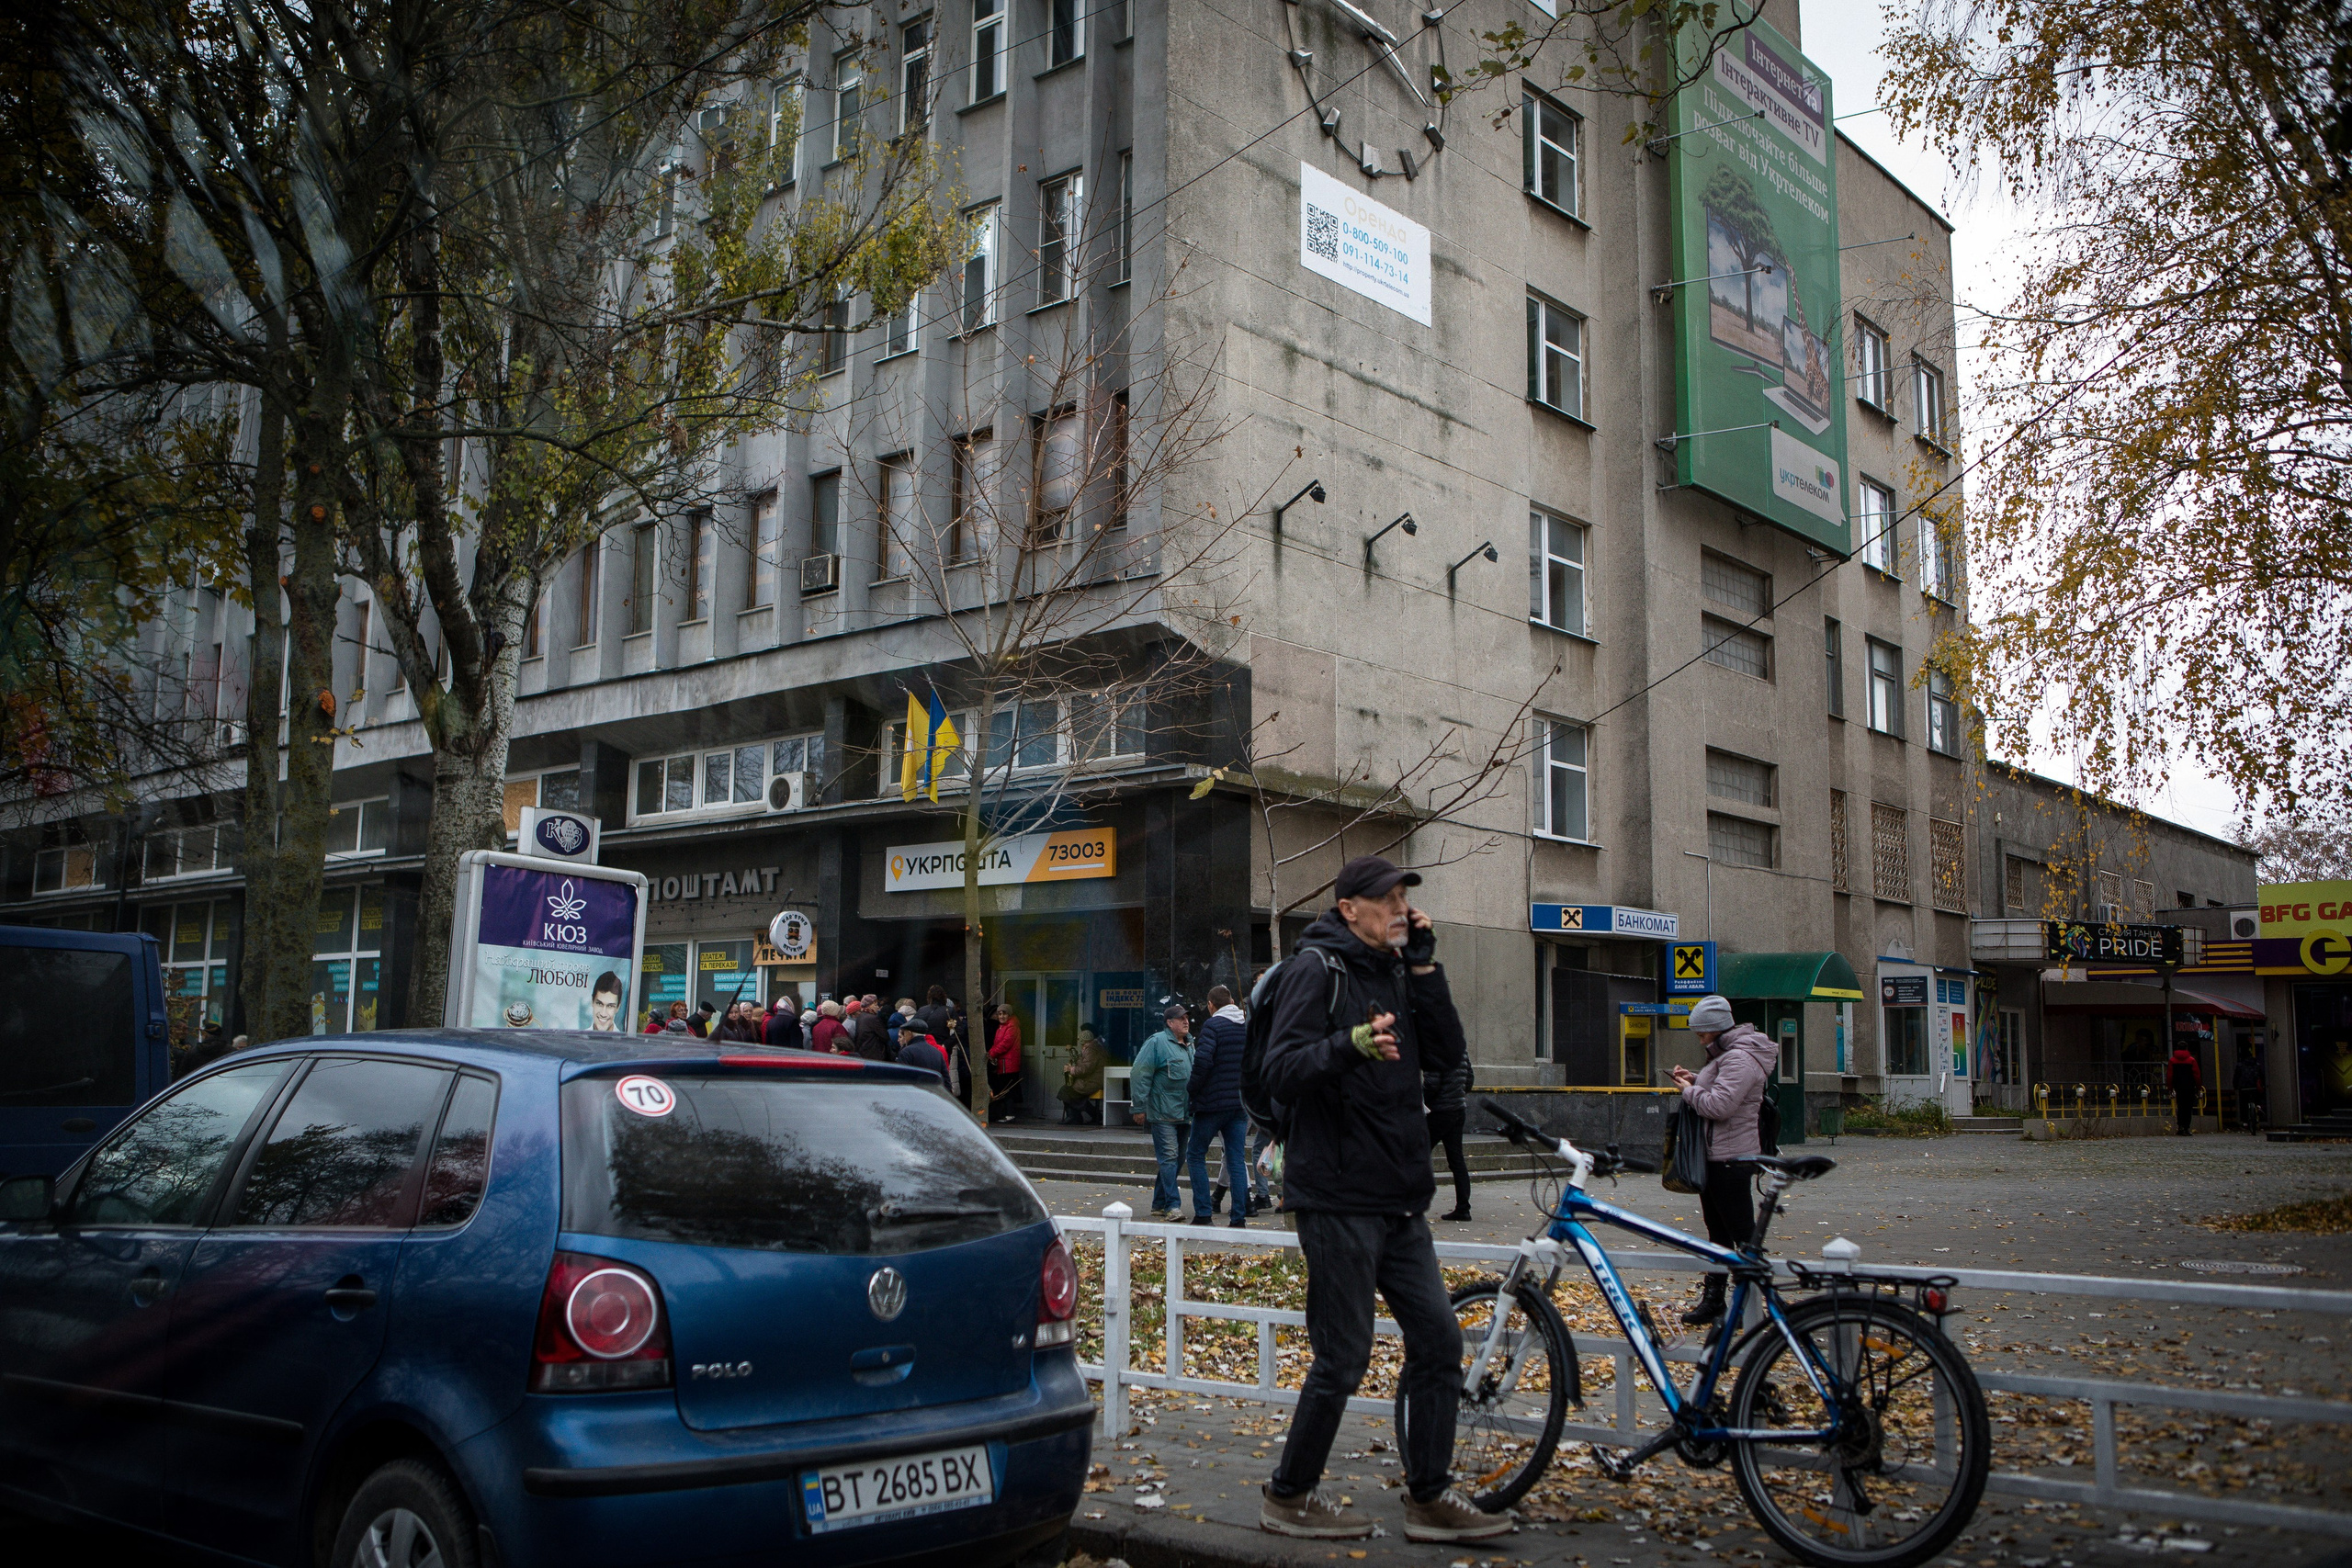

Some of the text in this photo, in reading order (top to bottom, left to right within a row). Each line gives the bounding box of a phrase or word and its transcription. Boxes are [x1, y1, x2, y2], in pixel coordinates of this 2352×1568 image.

[1751, 39, 1818, 113] Інтернет та
[1721, 52, 1819, 148] Інтерактивне TV
[1703, 85, 1828, 198] Підключайте більше
[1693, 109, 1829, 225] розваг від Укртелеком
[1344, 197, 1407, 243] Оренда
[1342, 221, 1408, 265] 0-800-509-100
[1342, 242, 1408, 285] 091-114-73-14
[1779, 468, 1830, 503] укртелеком
[1048, 841, 1105, 862] 73003
[649, 867, 780, 900] ПОШТАМТ
[1618, 914, 1675, 932] БАНКОМАТ
[2260, 901, 2352, 923] BFG GA
[544, 922, 587, 944] КЮЗ
[2133, 929, 2162, 938] ТАНЦА
[523, 939, 603, 954] КИЇВСЬКИЙ ЮВЕЛІРНИЙ ЗАВОД
[2099, 938, 2163, 957] PRIDE
[485, 951, 591, 974] Найкращий прояв
[708, 961, 737, 969] ПЕРЕКАЗИ
[527, 969, 588, 988] ЛЮБОВІ
[1974, 976, 1997, 990] PRIDE
[628, 1086, 664, 1105] 70
[1594, 1257, 1637, 1332] TREK
[692, 1360, 752, 1380] POLO
[808, 1453, 981, 1516] UA BT 2685 BX
